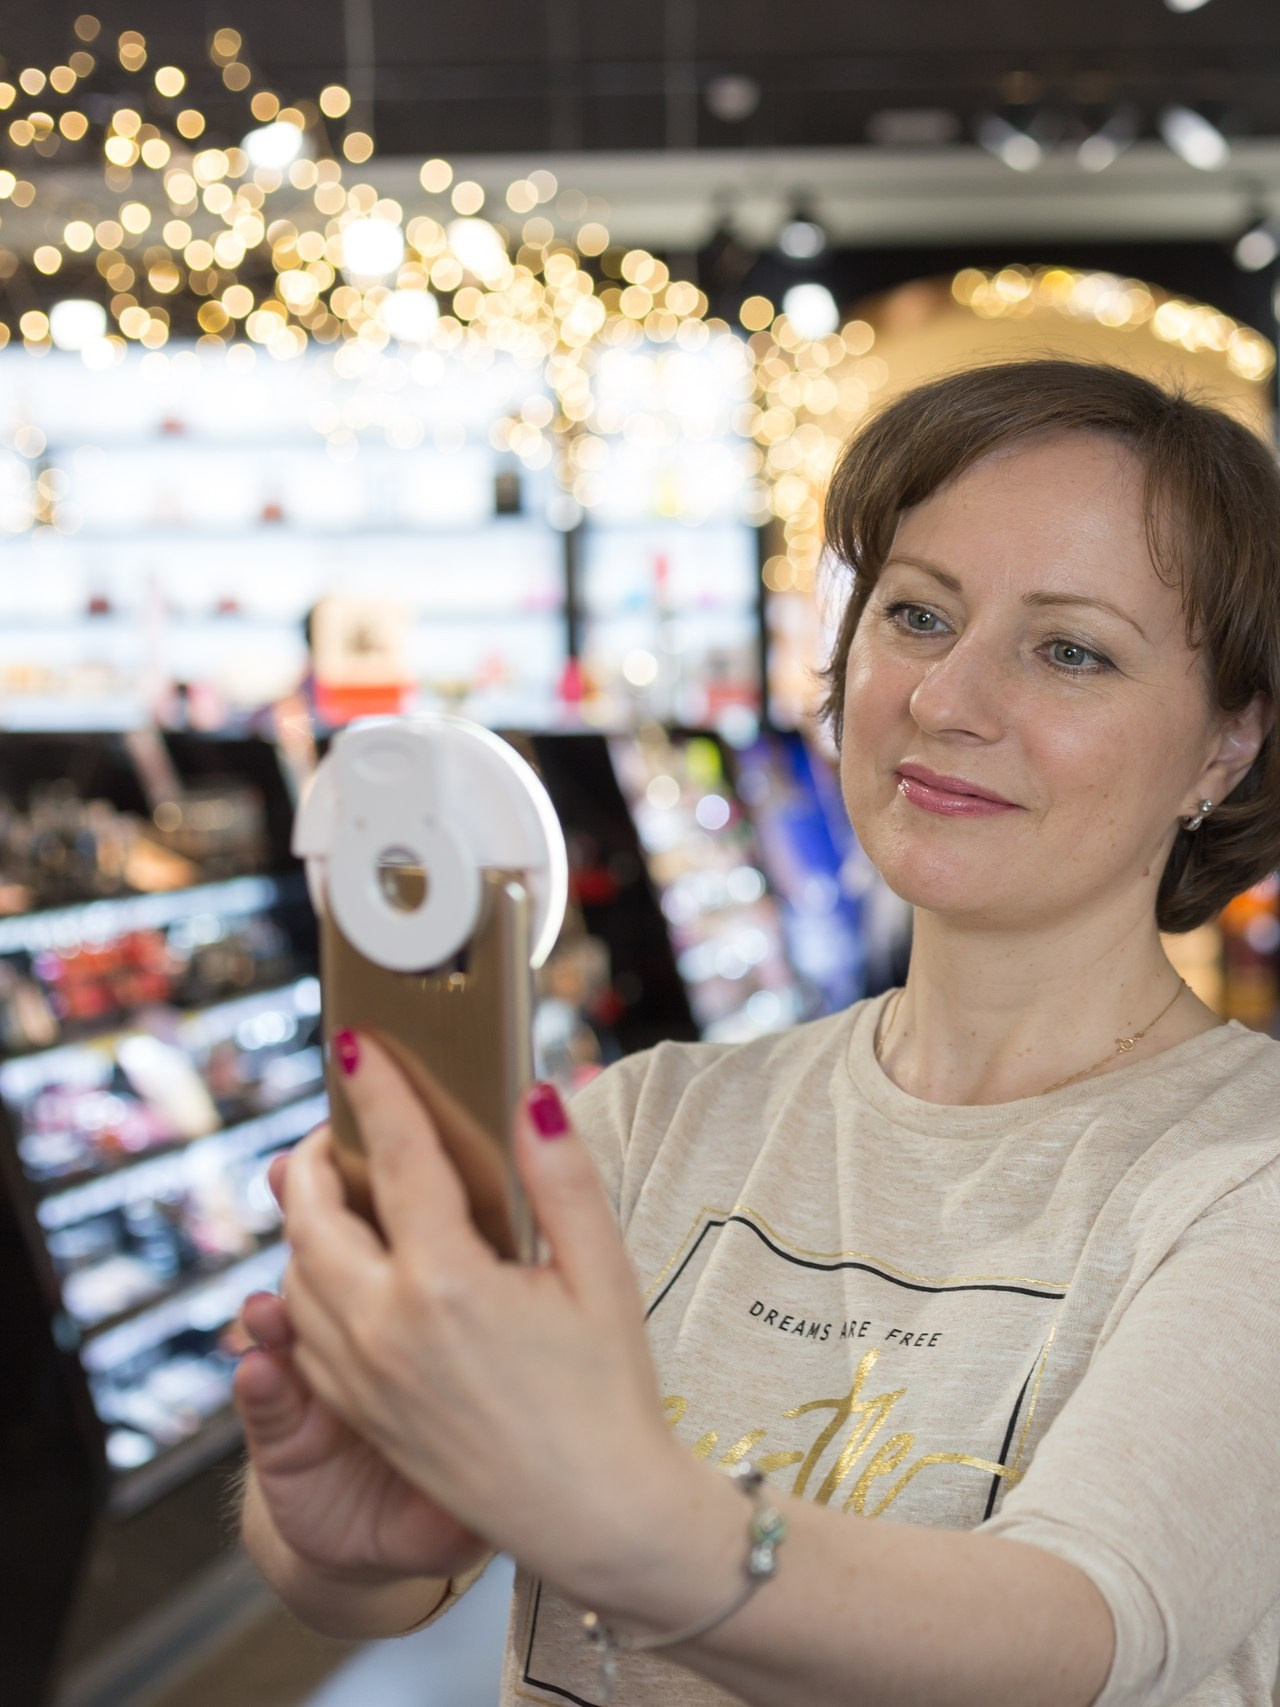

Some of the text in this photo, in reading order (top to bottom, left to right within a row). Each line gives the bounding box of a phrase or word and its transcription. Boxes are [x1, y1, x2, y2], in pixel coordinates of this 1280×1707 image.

[747, 1300, 944, 1349] DREAMS ARE FREE
